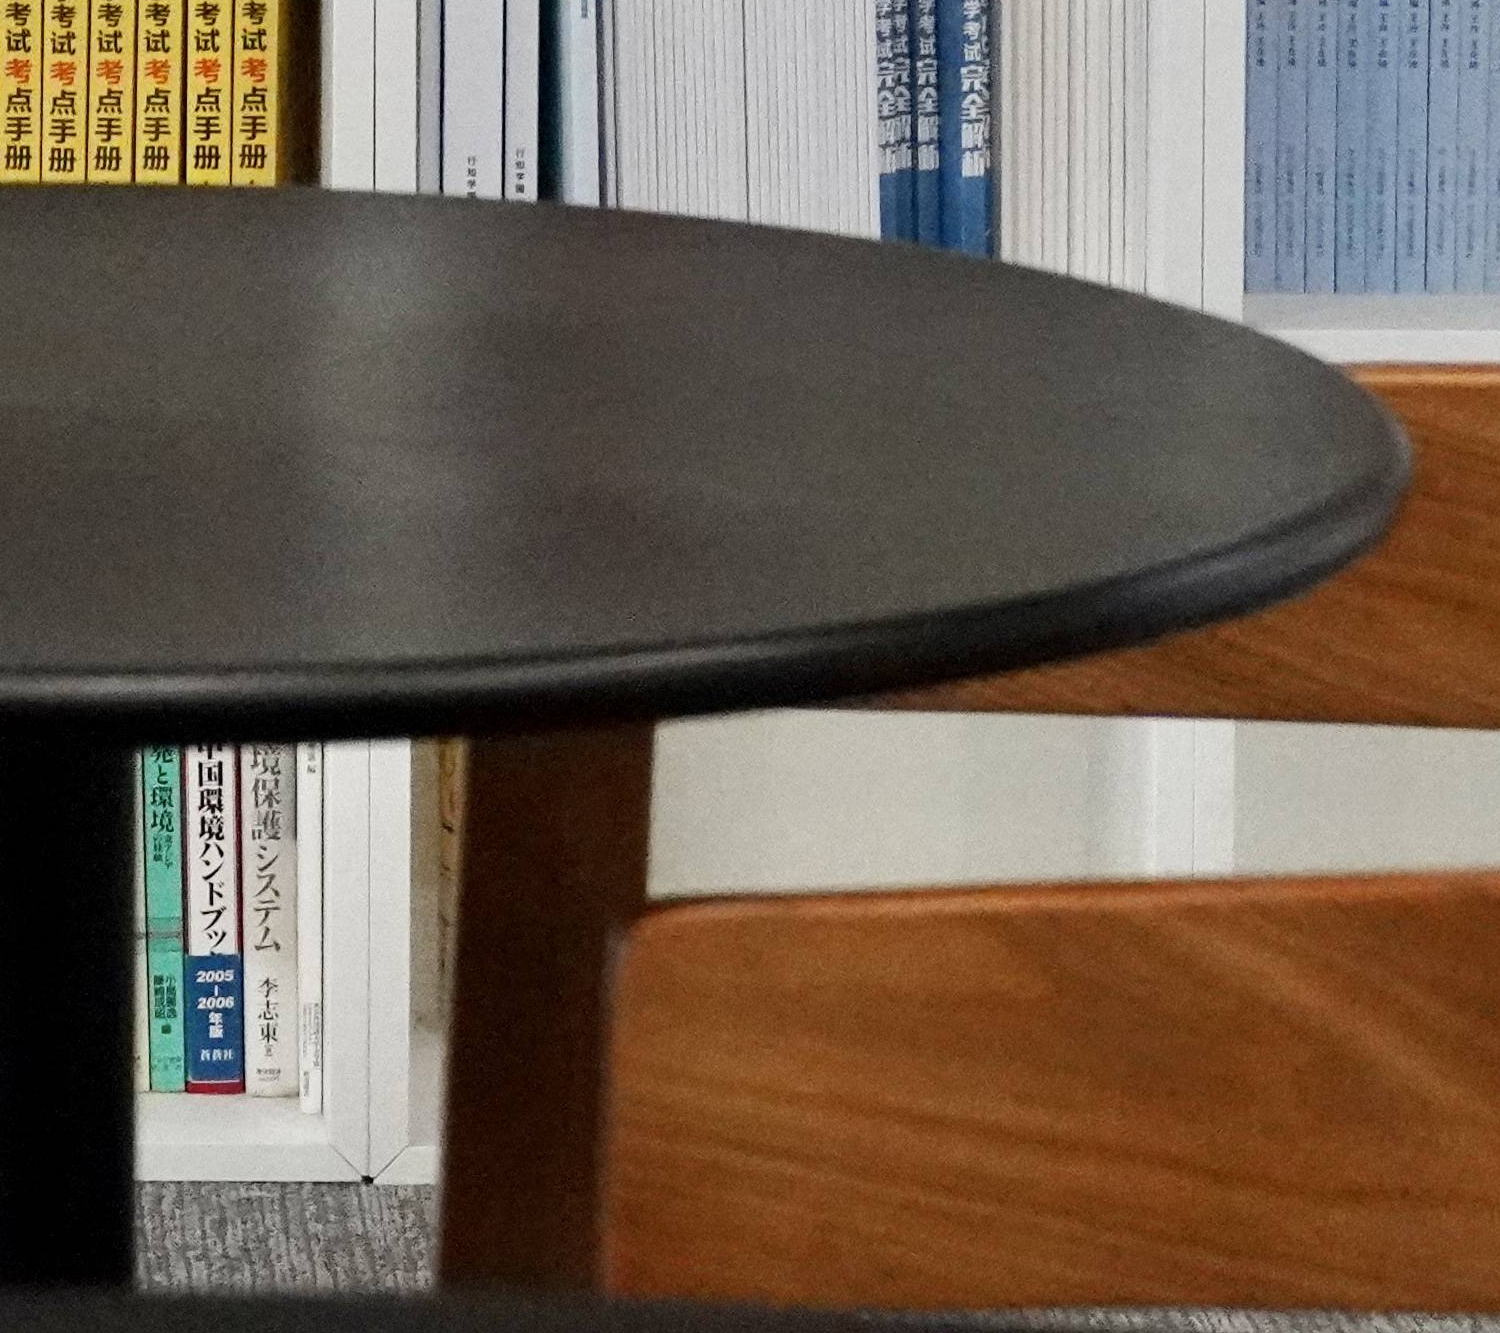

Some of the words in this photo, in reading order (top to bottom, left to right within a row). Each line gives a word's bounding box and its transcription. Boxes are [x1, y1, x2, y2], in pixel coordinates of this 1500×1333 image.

[197, 742, 225, 955] 中国環境ハンドブッ
[196, 969, 235, 982] 2005
[197, 996, 235, 1010] 2006
[258, 977, 280, 1043] 李志東
